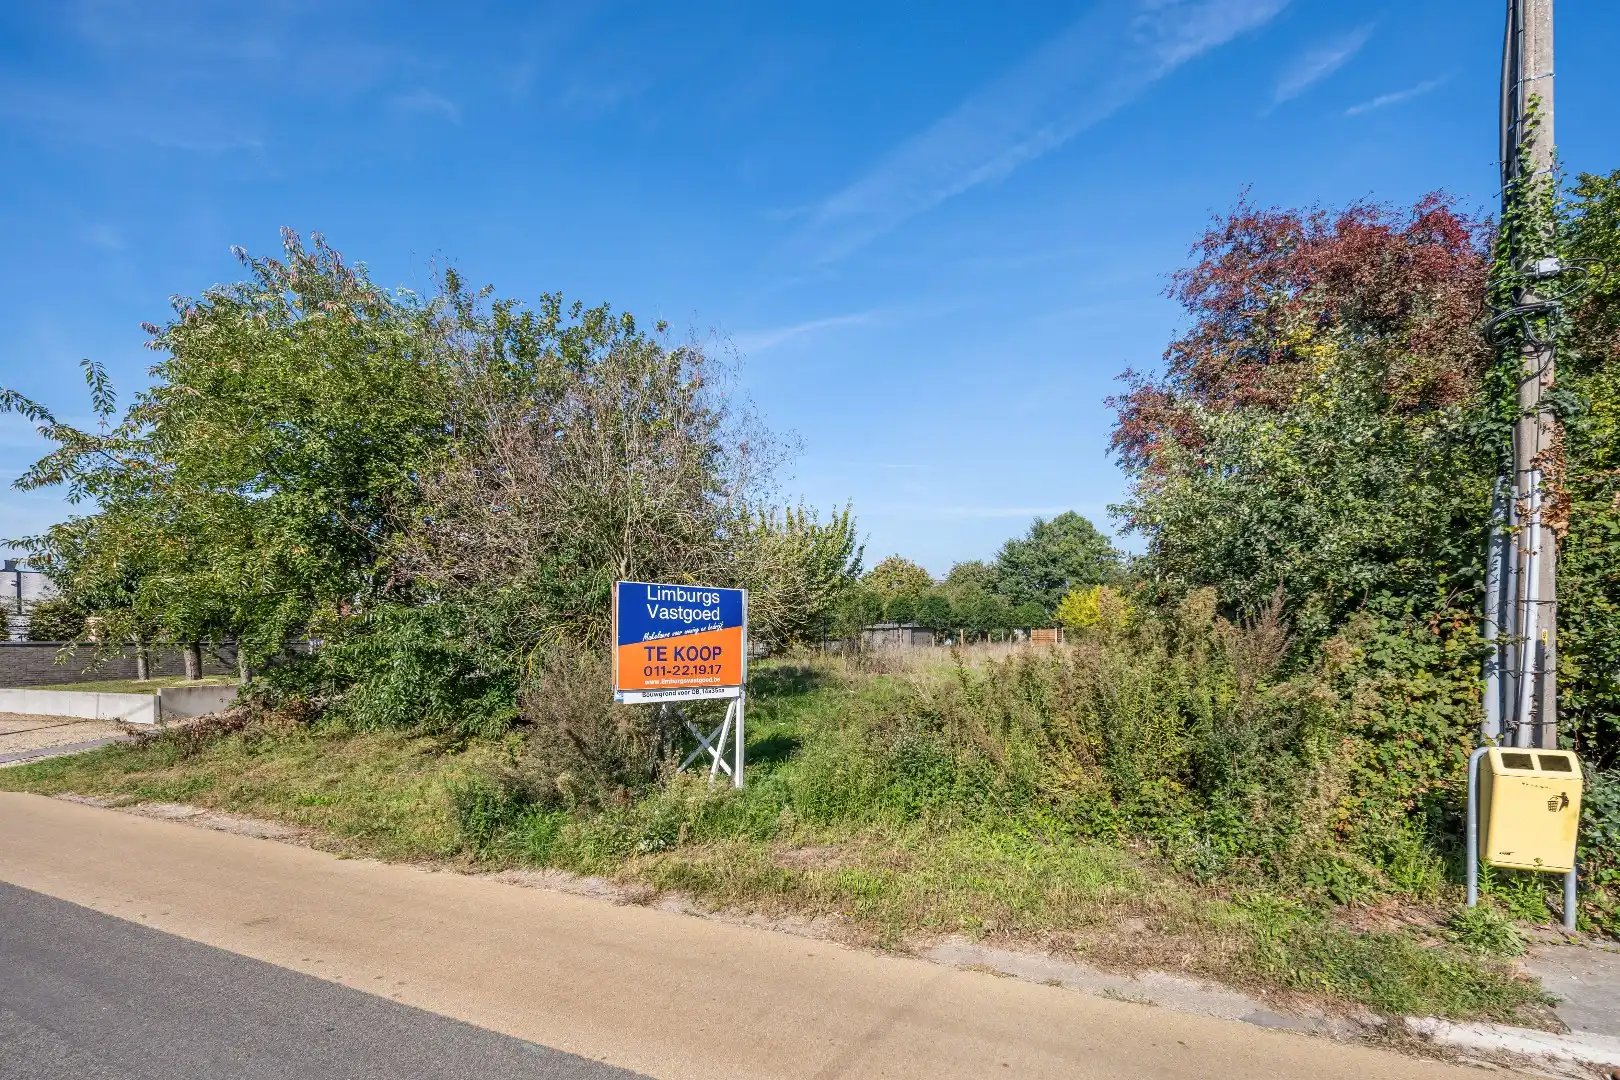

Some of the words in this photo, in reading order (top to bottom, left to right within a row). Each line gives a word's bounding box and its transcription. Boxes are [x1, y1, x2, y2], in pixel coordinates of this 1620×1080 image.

[647, 585, 720, 606] Limburgs
[647, 603, 720, 623] Vastgoed
[643, 646, 668, 661] TE
[674, 645, 722, 661] KOOP
[643, 664, 722, 677] 011-22.19.17
[644, 677, 720, 685] www.limburgsvastgoed.be
[642, 688, 676, 698] Bouwgrond
